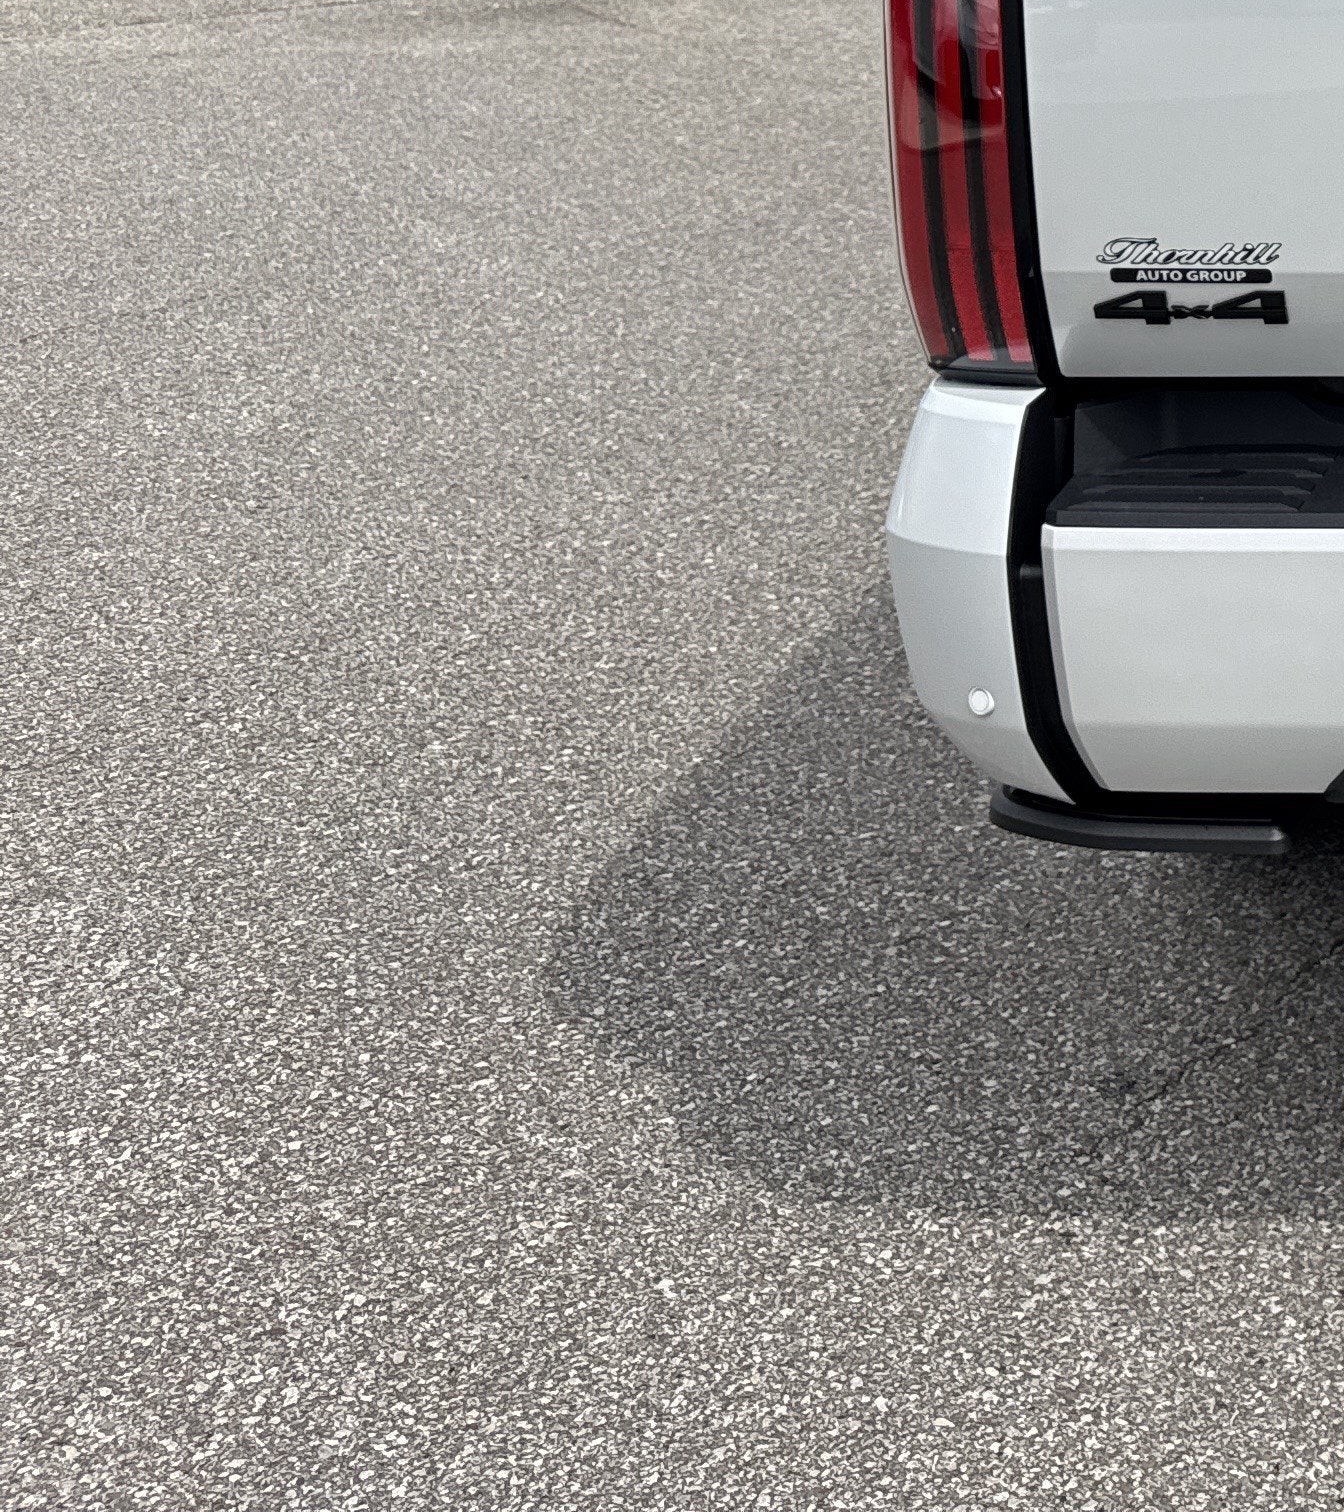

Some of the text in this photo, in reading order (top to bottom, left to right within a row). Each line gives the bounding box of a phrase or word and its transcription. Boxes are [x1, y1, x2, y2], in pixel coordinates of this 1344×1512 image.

[1096, 237, 1283, 265] Thornhill
[1135, 269, 1247, 282] AUTO GROUP
[1093, 289, 1290, 325] 4x4
